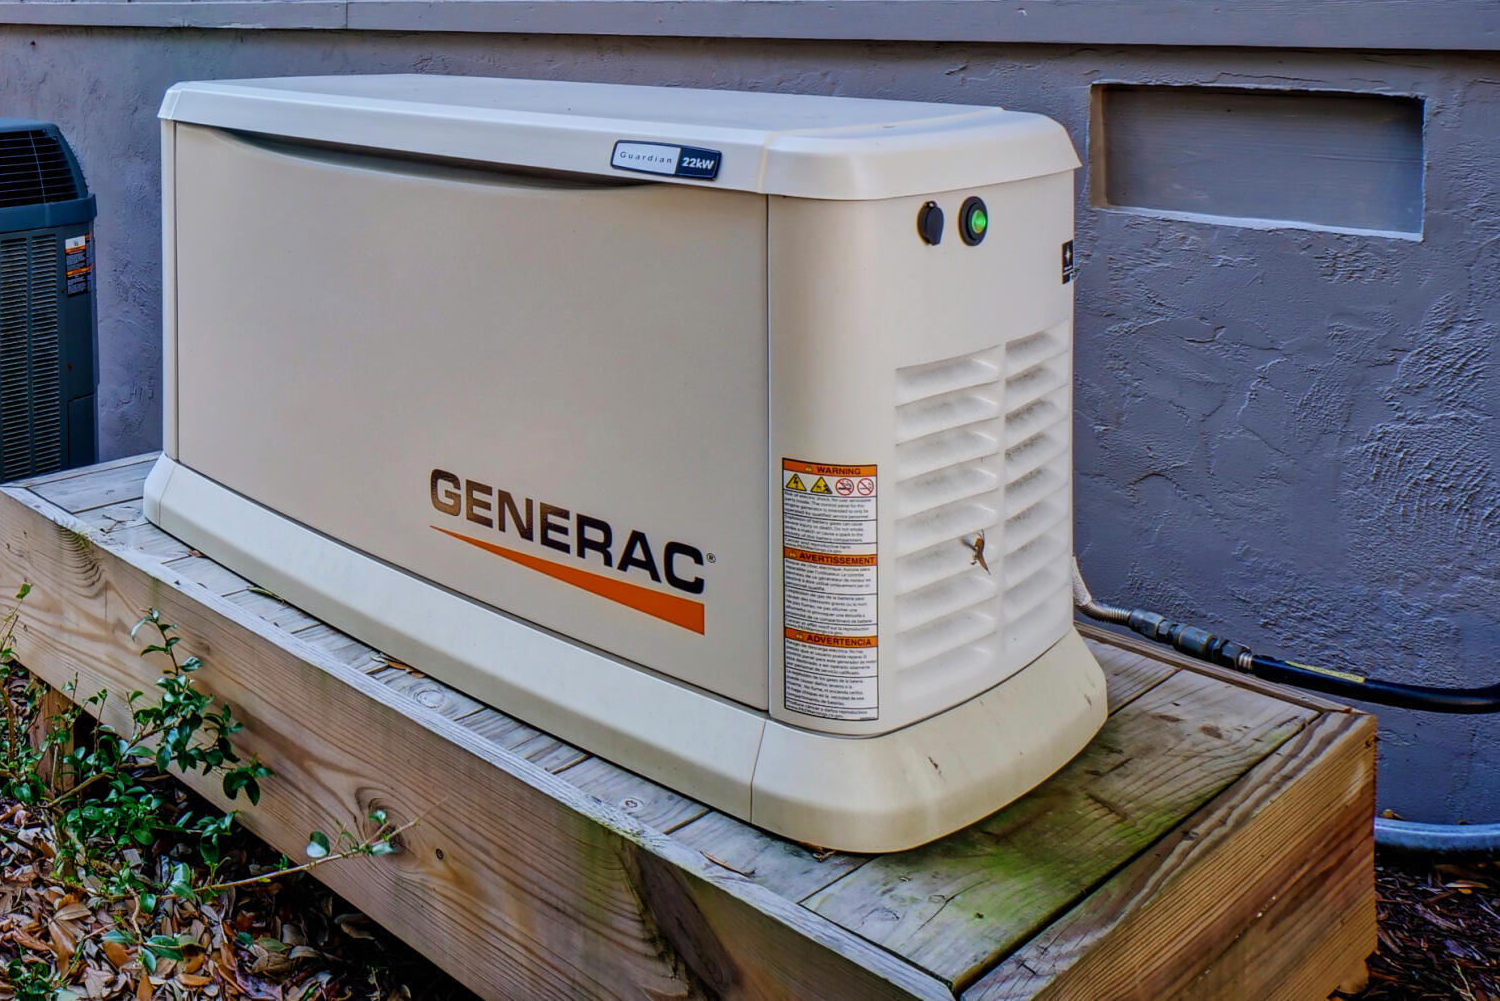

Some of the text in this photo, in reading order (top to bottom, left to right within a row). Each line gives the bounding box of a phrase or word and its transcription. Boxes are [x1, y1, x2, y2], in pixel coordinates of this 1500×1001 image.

[619, 151, 714, 170] Guardian 22kW
[816, 466, 861, 475] WARNING
[799, 552, 875, 565] AVERTISSEMENT
[807, 634, 872, 646] ADVERTENCIA
